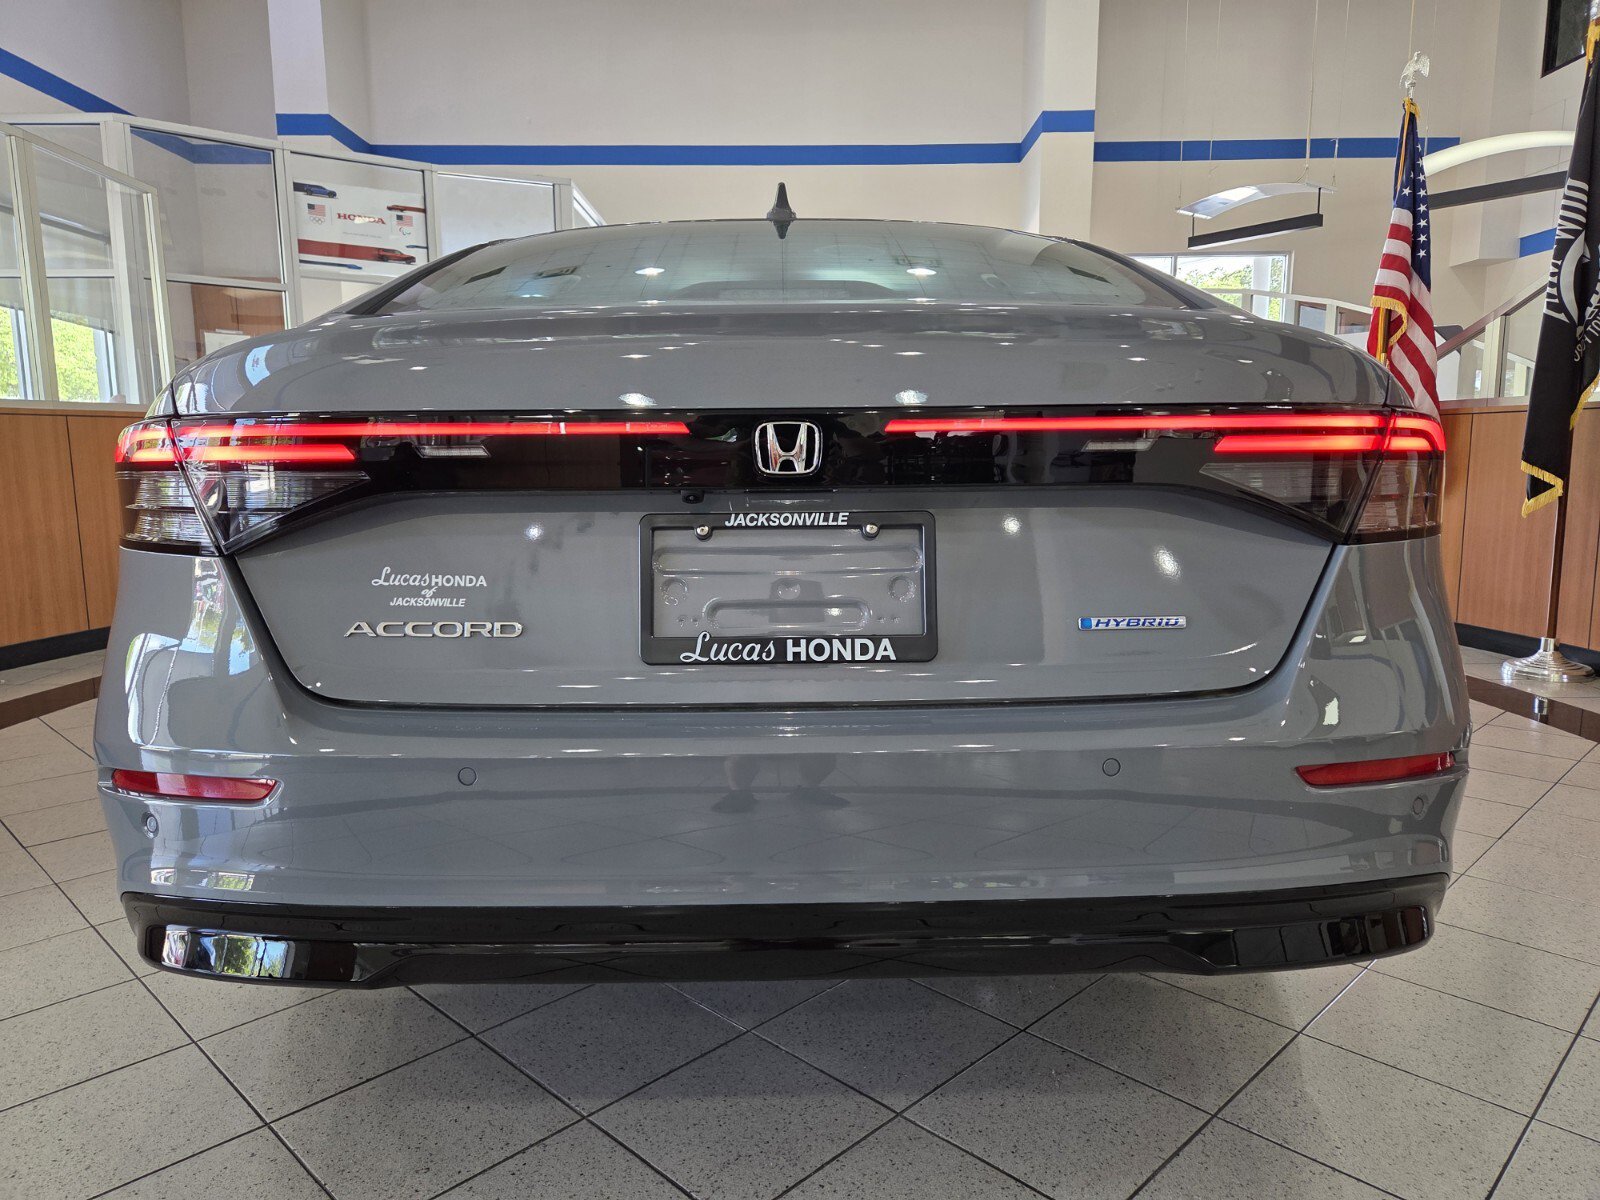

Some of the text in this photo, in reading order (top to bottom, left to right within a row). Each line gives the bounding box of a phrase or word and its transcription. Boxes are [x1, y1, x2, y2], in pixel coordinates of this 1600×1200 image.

[724, 512, 850, 528] JACKSONVILLE
[372, 567, 487, 587] Lucas HONDA
[421, 587, 438, 597] of
[389, 597, 467, 608] JACKSONVILLE
[343, 620, 524, 639] ACCORD
[1095, 618, 1181, 628] HYBRID
[679, 630, 897, 663] Lucas HONDA
